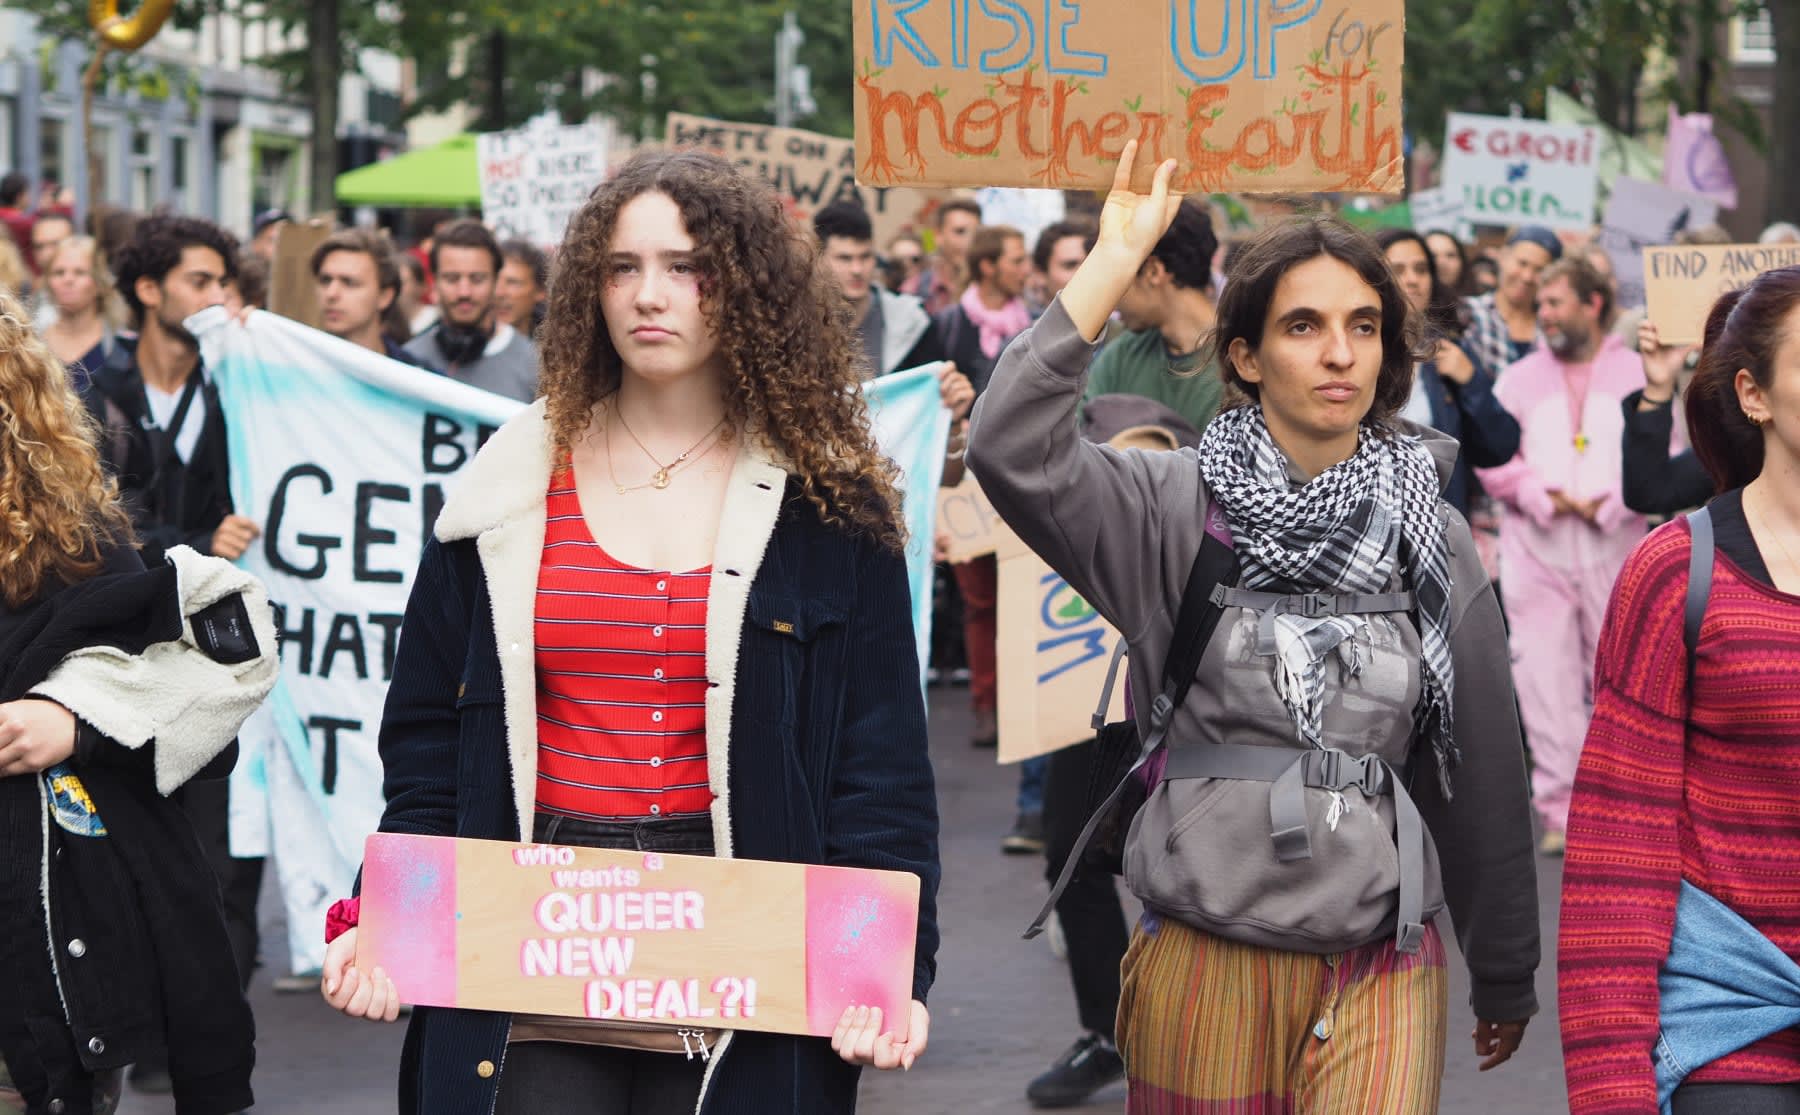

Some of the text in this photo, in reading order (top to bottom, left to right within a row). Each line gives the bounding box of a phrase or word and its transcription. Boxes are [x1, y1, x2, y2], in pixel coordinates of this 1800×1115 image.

[869, 0, 1393, 84] RISE UP for
[858, 61, 1397, 188] mother Earth
[786, 137, 827, 160] ON
[1651, 251, 1708, 278] FIND
[513, 843, 576, 865] who
[552, 853, 665, 888] wants a
[534, 891, 705, 934] QUEER
[521, 937, 635, 976] NEW
[583, 977, 758, 1019] DEAL?!
